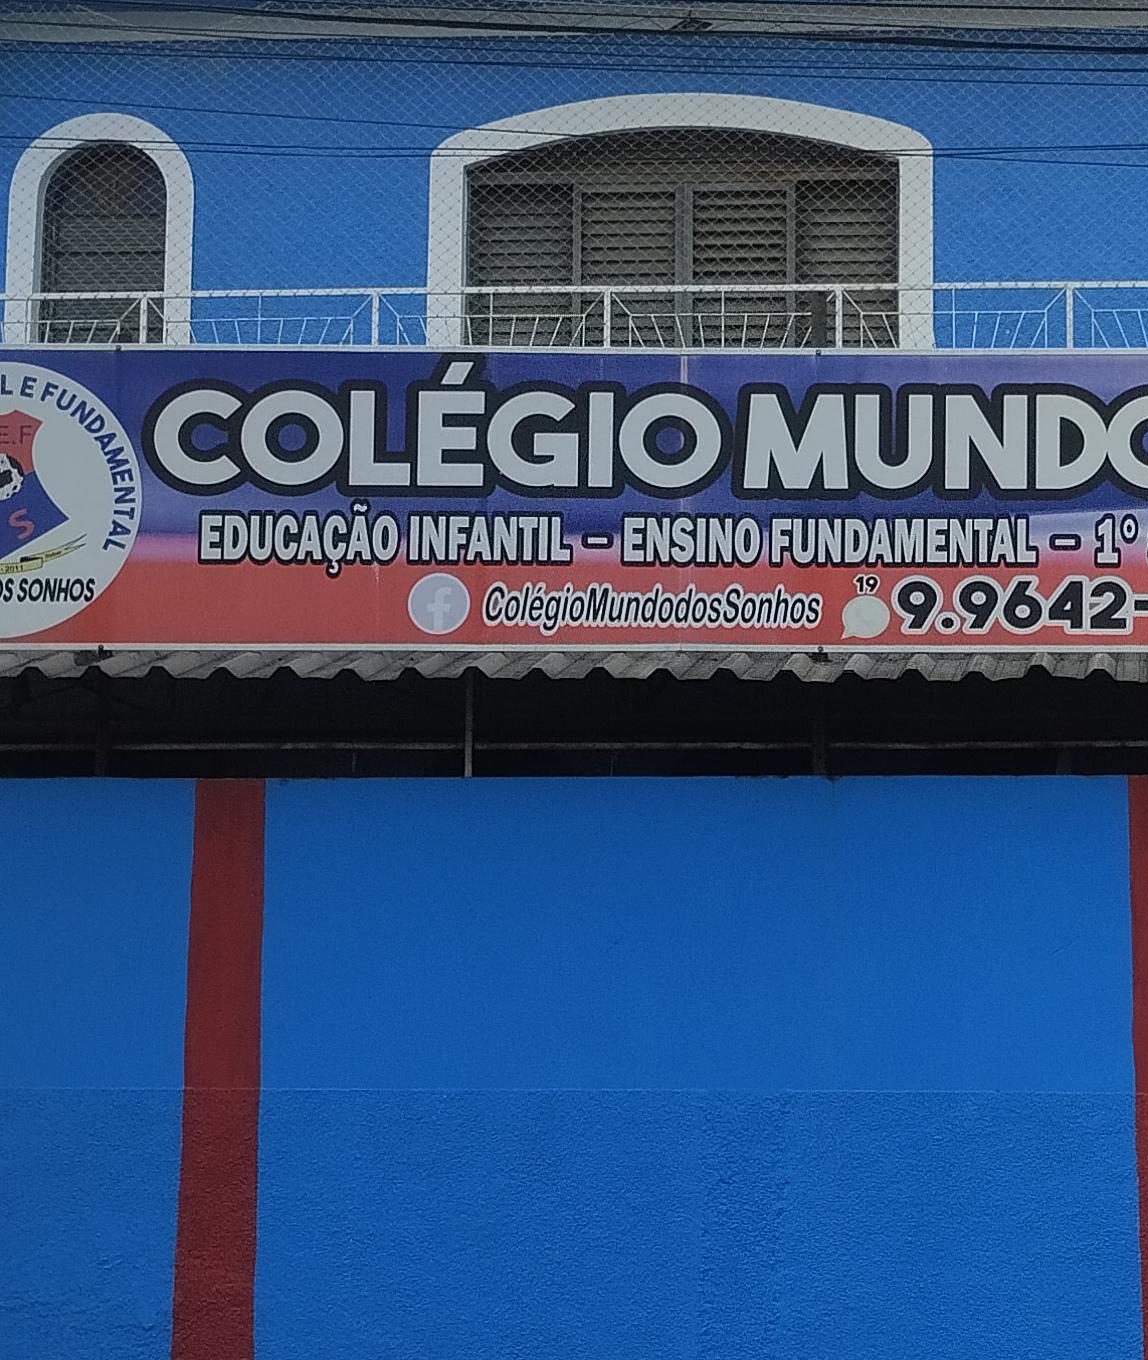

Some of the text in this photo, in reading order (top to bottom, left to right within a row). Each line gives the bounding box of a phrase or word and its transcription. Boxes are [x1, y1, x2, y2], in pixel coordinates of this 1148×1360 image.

[154, 362, 721, 489] COLÉGIO
[40, 381, 136, 551] FUNDAMENTAL
[199, 503, 398, 574] EDUCAÇÃO
[409, 515, 571, 562] INFANTIL
[624, 517, 760, 564] ENSINO
[771, 517, 1037, 565] FUNDAMENTAL
[17, 578, 95, 602] SONHOS
[485, 585, 821, 632] ColégioMundodosSonhos
[855, 575, 878, 593] 19
